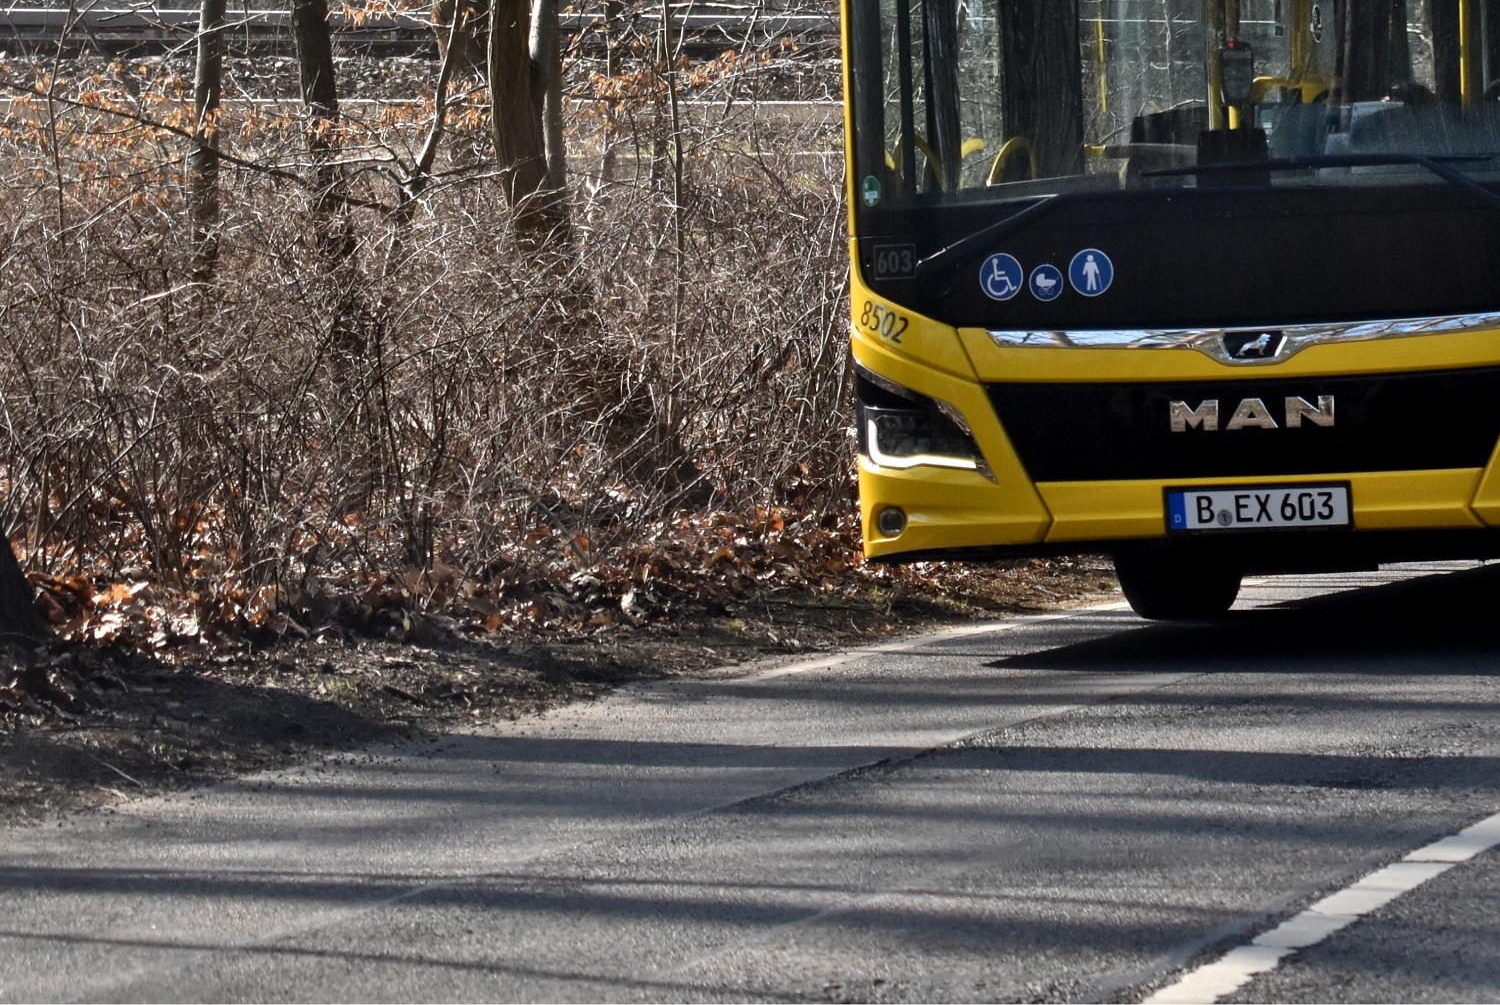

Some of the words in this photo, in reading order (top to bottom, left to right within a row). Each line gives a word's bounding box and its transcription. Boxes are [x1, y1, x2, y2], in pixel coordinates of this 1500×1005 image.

[877, 250, 913, 273] 603
[861, 300, 909, 344] 8502
[1169, 395, 1335, 432] MAN
[1196, 495, 1215, 524] B
